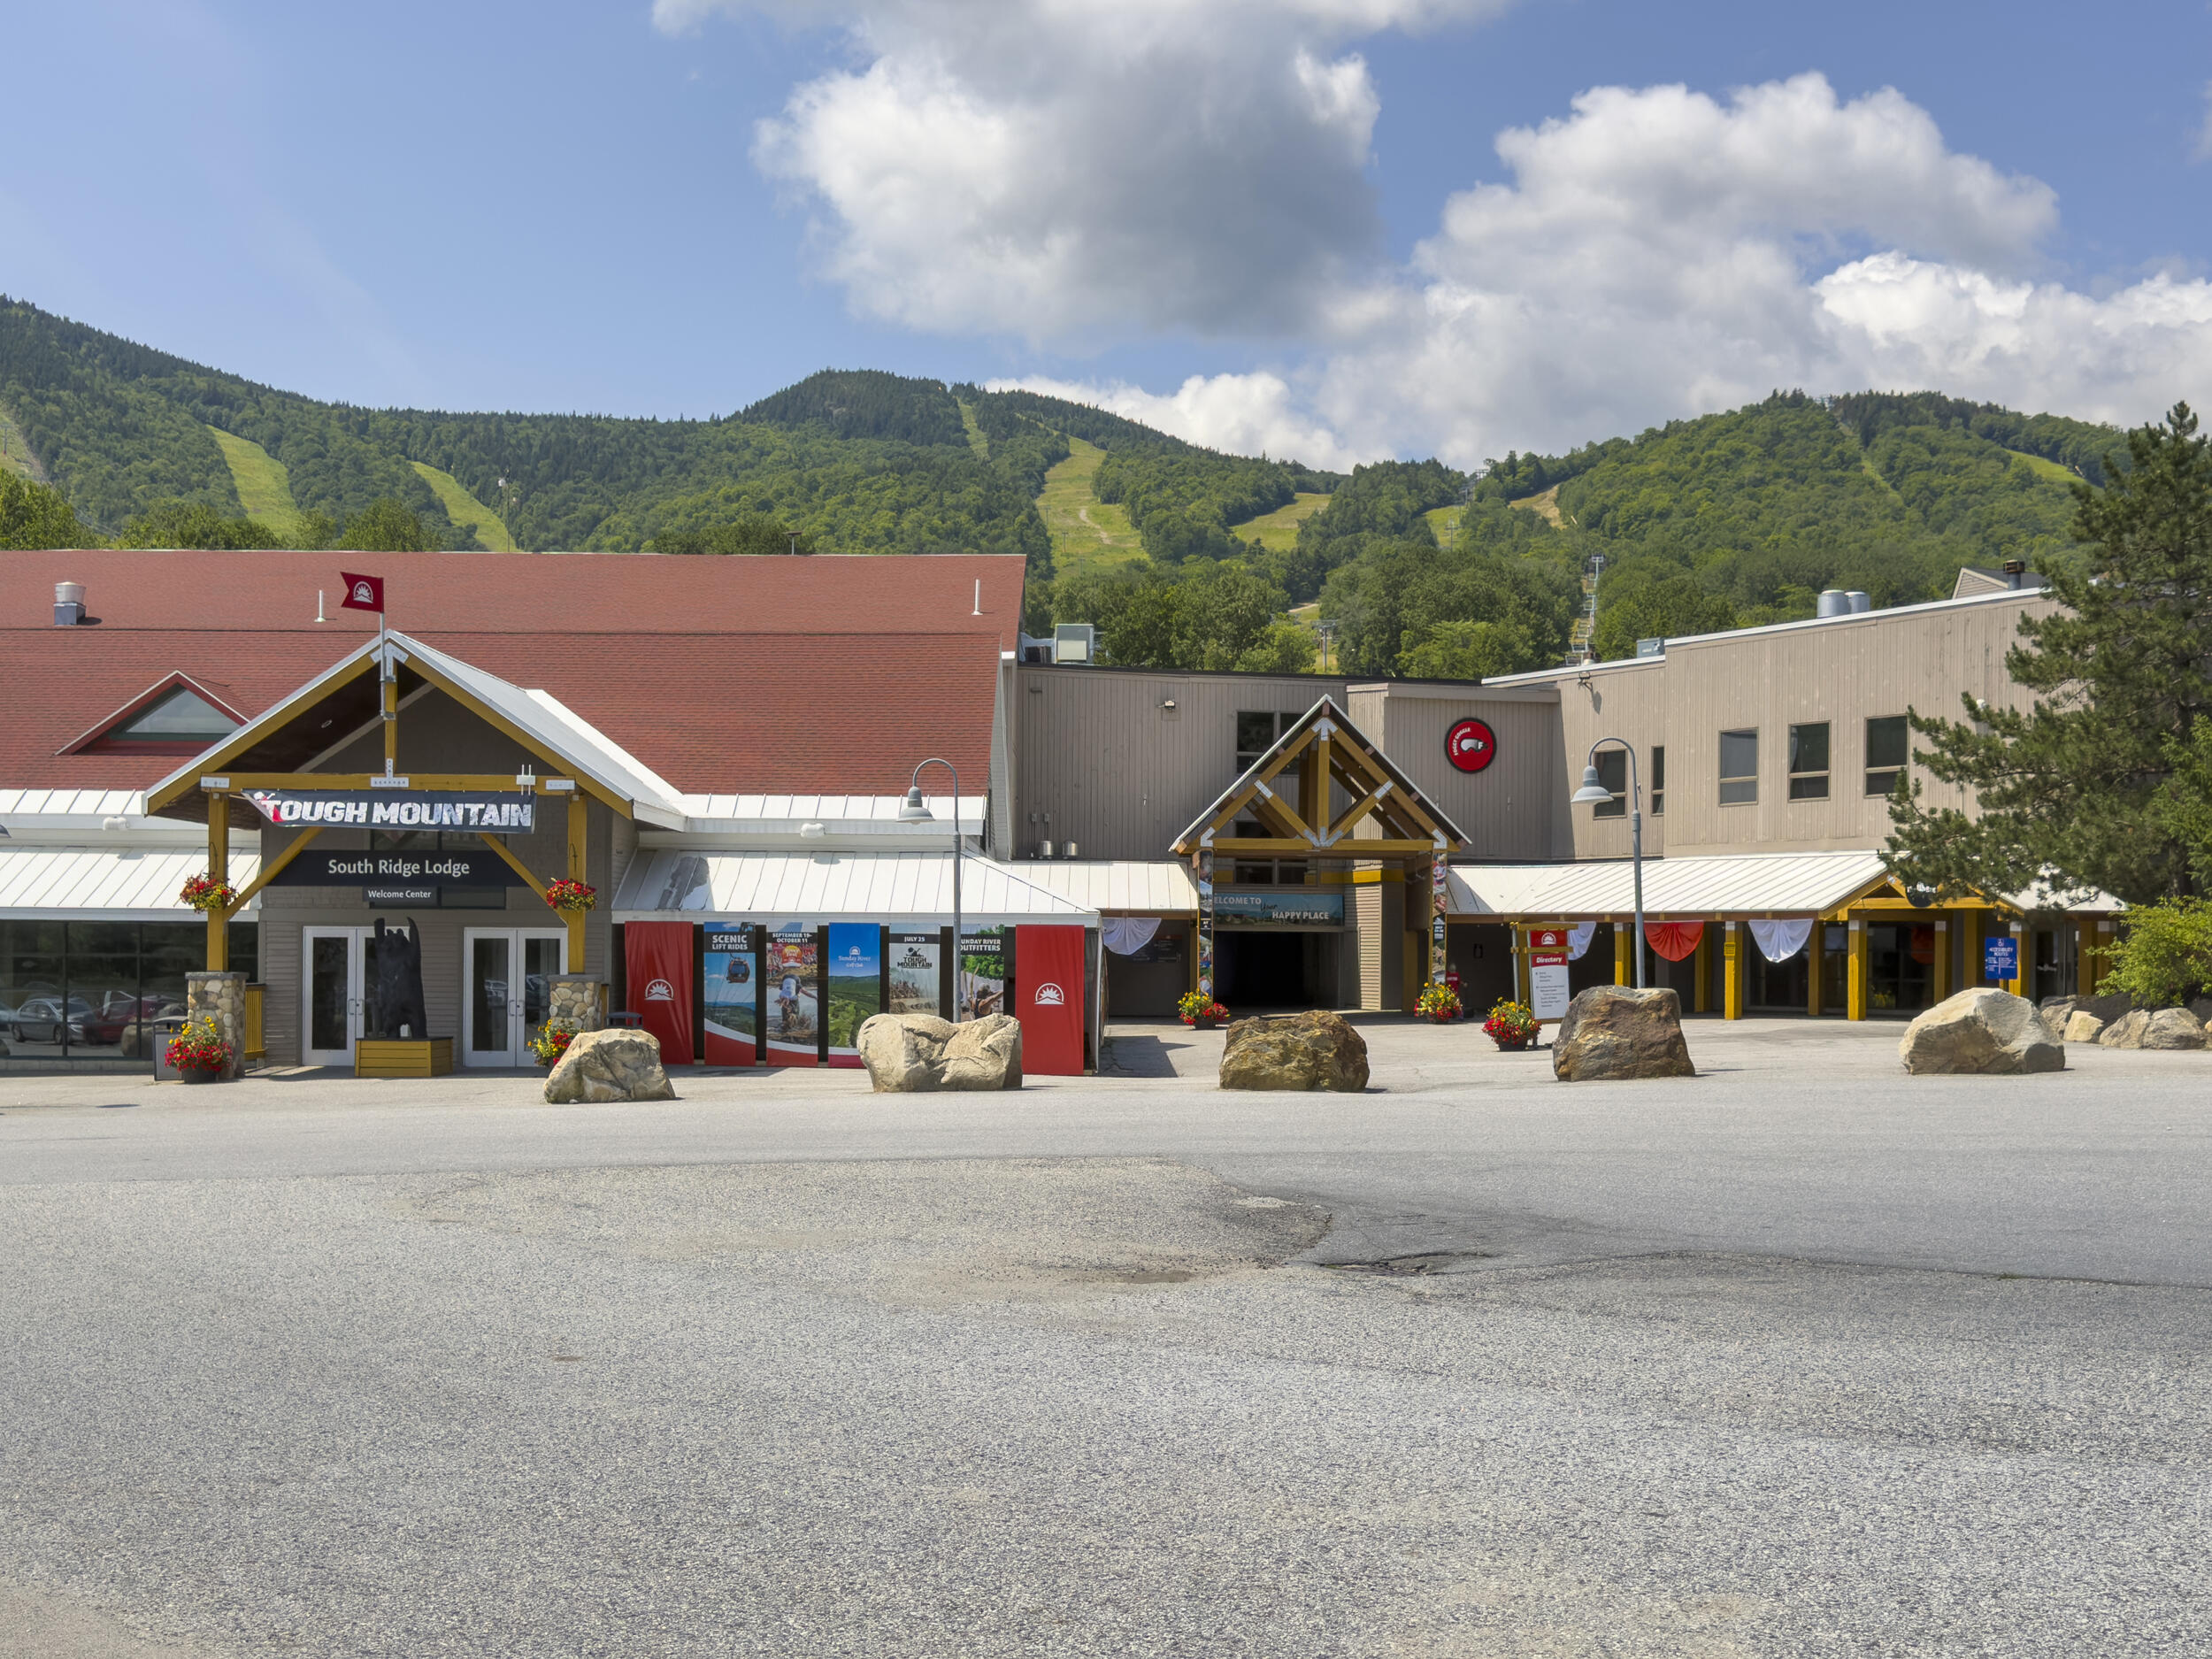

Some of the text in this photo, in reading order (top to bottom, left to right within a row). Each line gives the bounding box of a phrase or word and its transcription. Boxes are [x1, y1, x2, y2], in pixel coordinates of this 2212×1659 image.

[261, 799, 532, 827] TOUGH MOUNTAIN
[327, 858, 470, 879] South Ridge Lodge
[368, 889, 431, 899] Welcome Center
[1214, 896, 1248, 905] ELCOME
[712, 934, 748, 943] SCENIC
